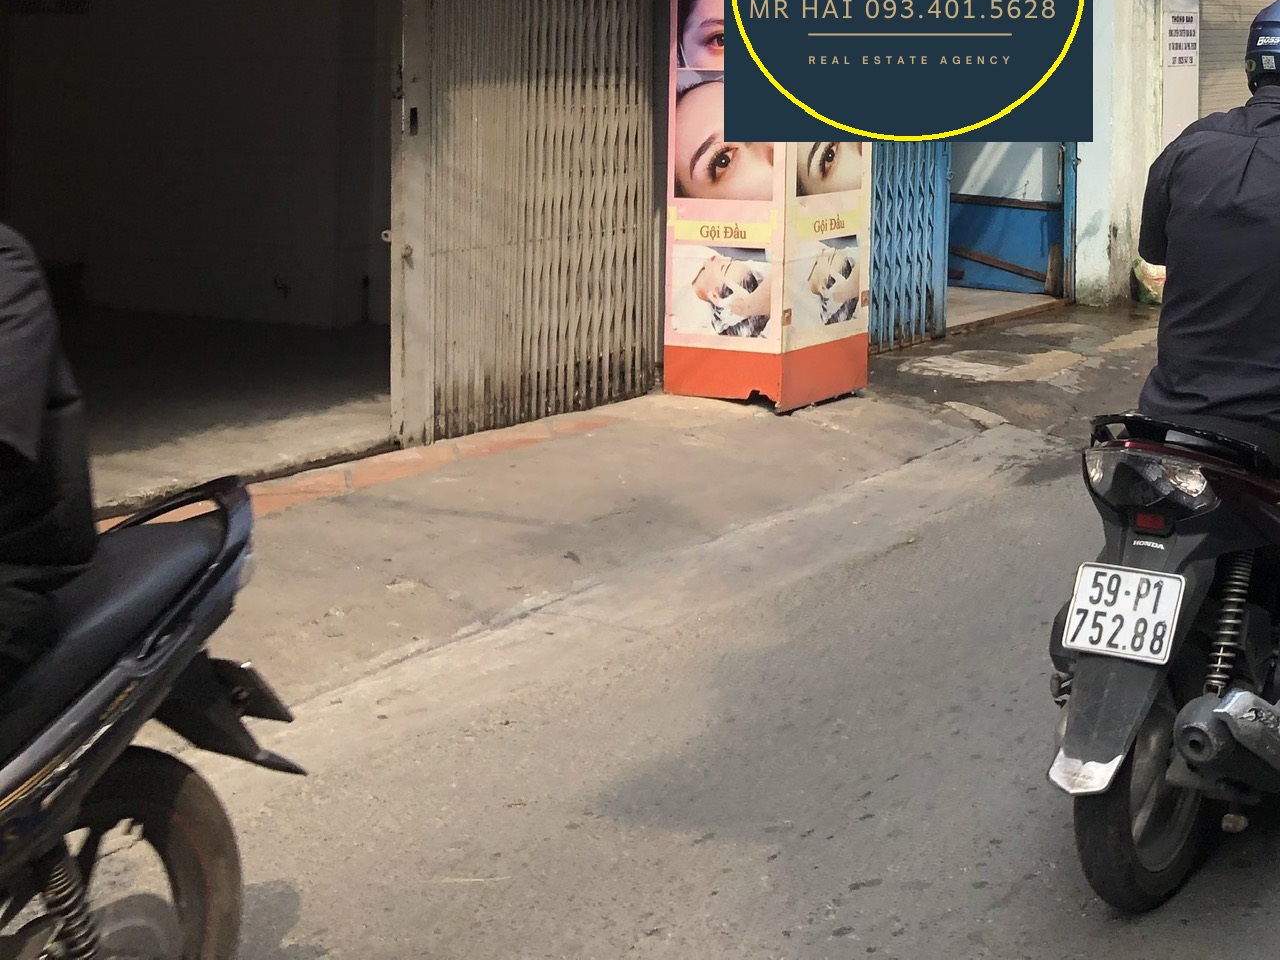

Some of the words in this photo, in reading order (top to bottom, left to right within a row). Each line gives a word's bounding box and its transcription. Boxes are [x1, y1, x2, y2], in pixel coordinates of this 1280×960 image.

[700, 225, 720, 240] Gội
[724, 223, 747, 239] Đầu
[813, 220, 828, 234] Gội
[830, 214, 845, 230] Đầu
[1132, 540, 1165, 550] HONDA
[1089, 571, 1164, 614] 59-P1
[1070, 608, 1167, 655] 752.88
